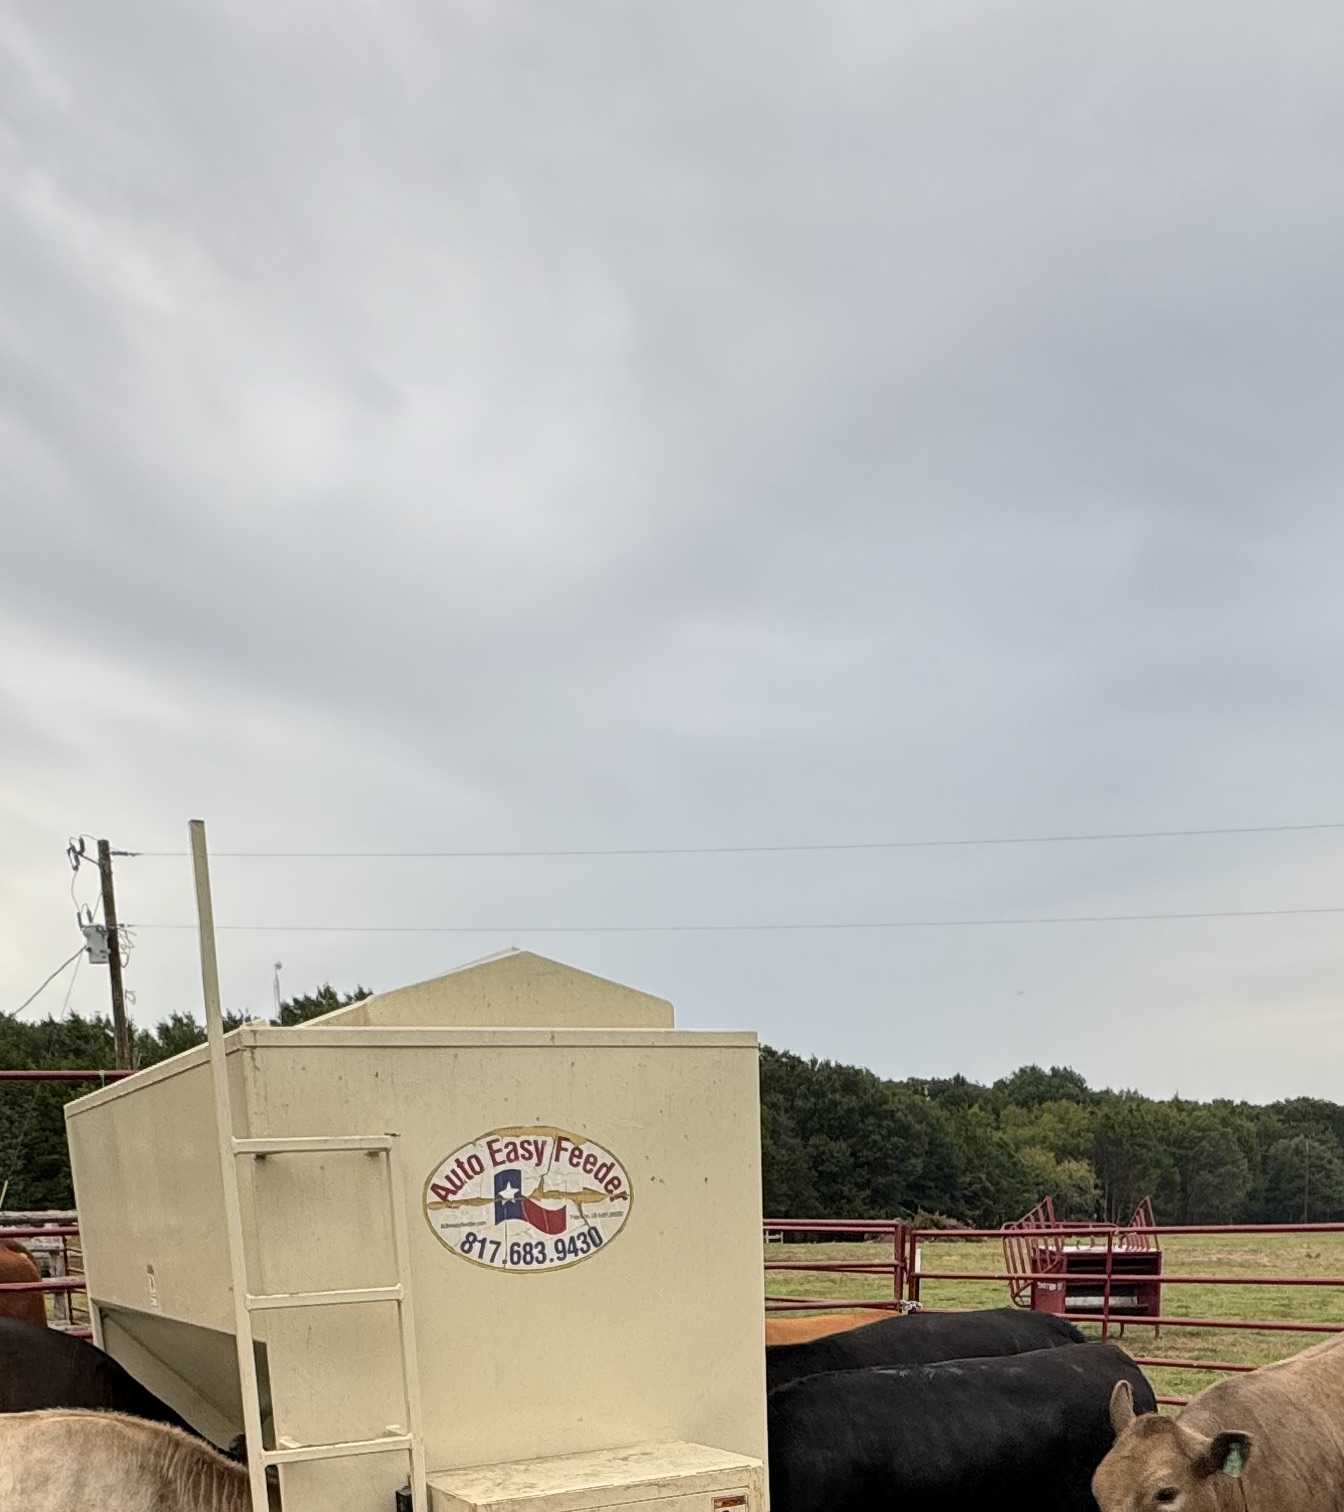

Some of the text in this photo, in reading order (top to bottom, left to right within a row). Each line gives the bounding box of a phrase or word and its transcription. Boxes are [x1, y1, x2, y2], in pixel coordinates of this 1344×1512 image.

[430, 1135, 628, 1202] Auto Easy Feeder
[460, 1226, 603, 1265] 817.683.9430
